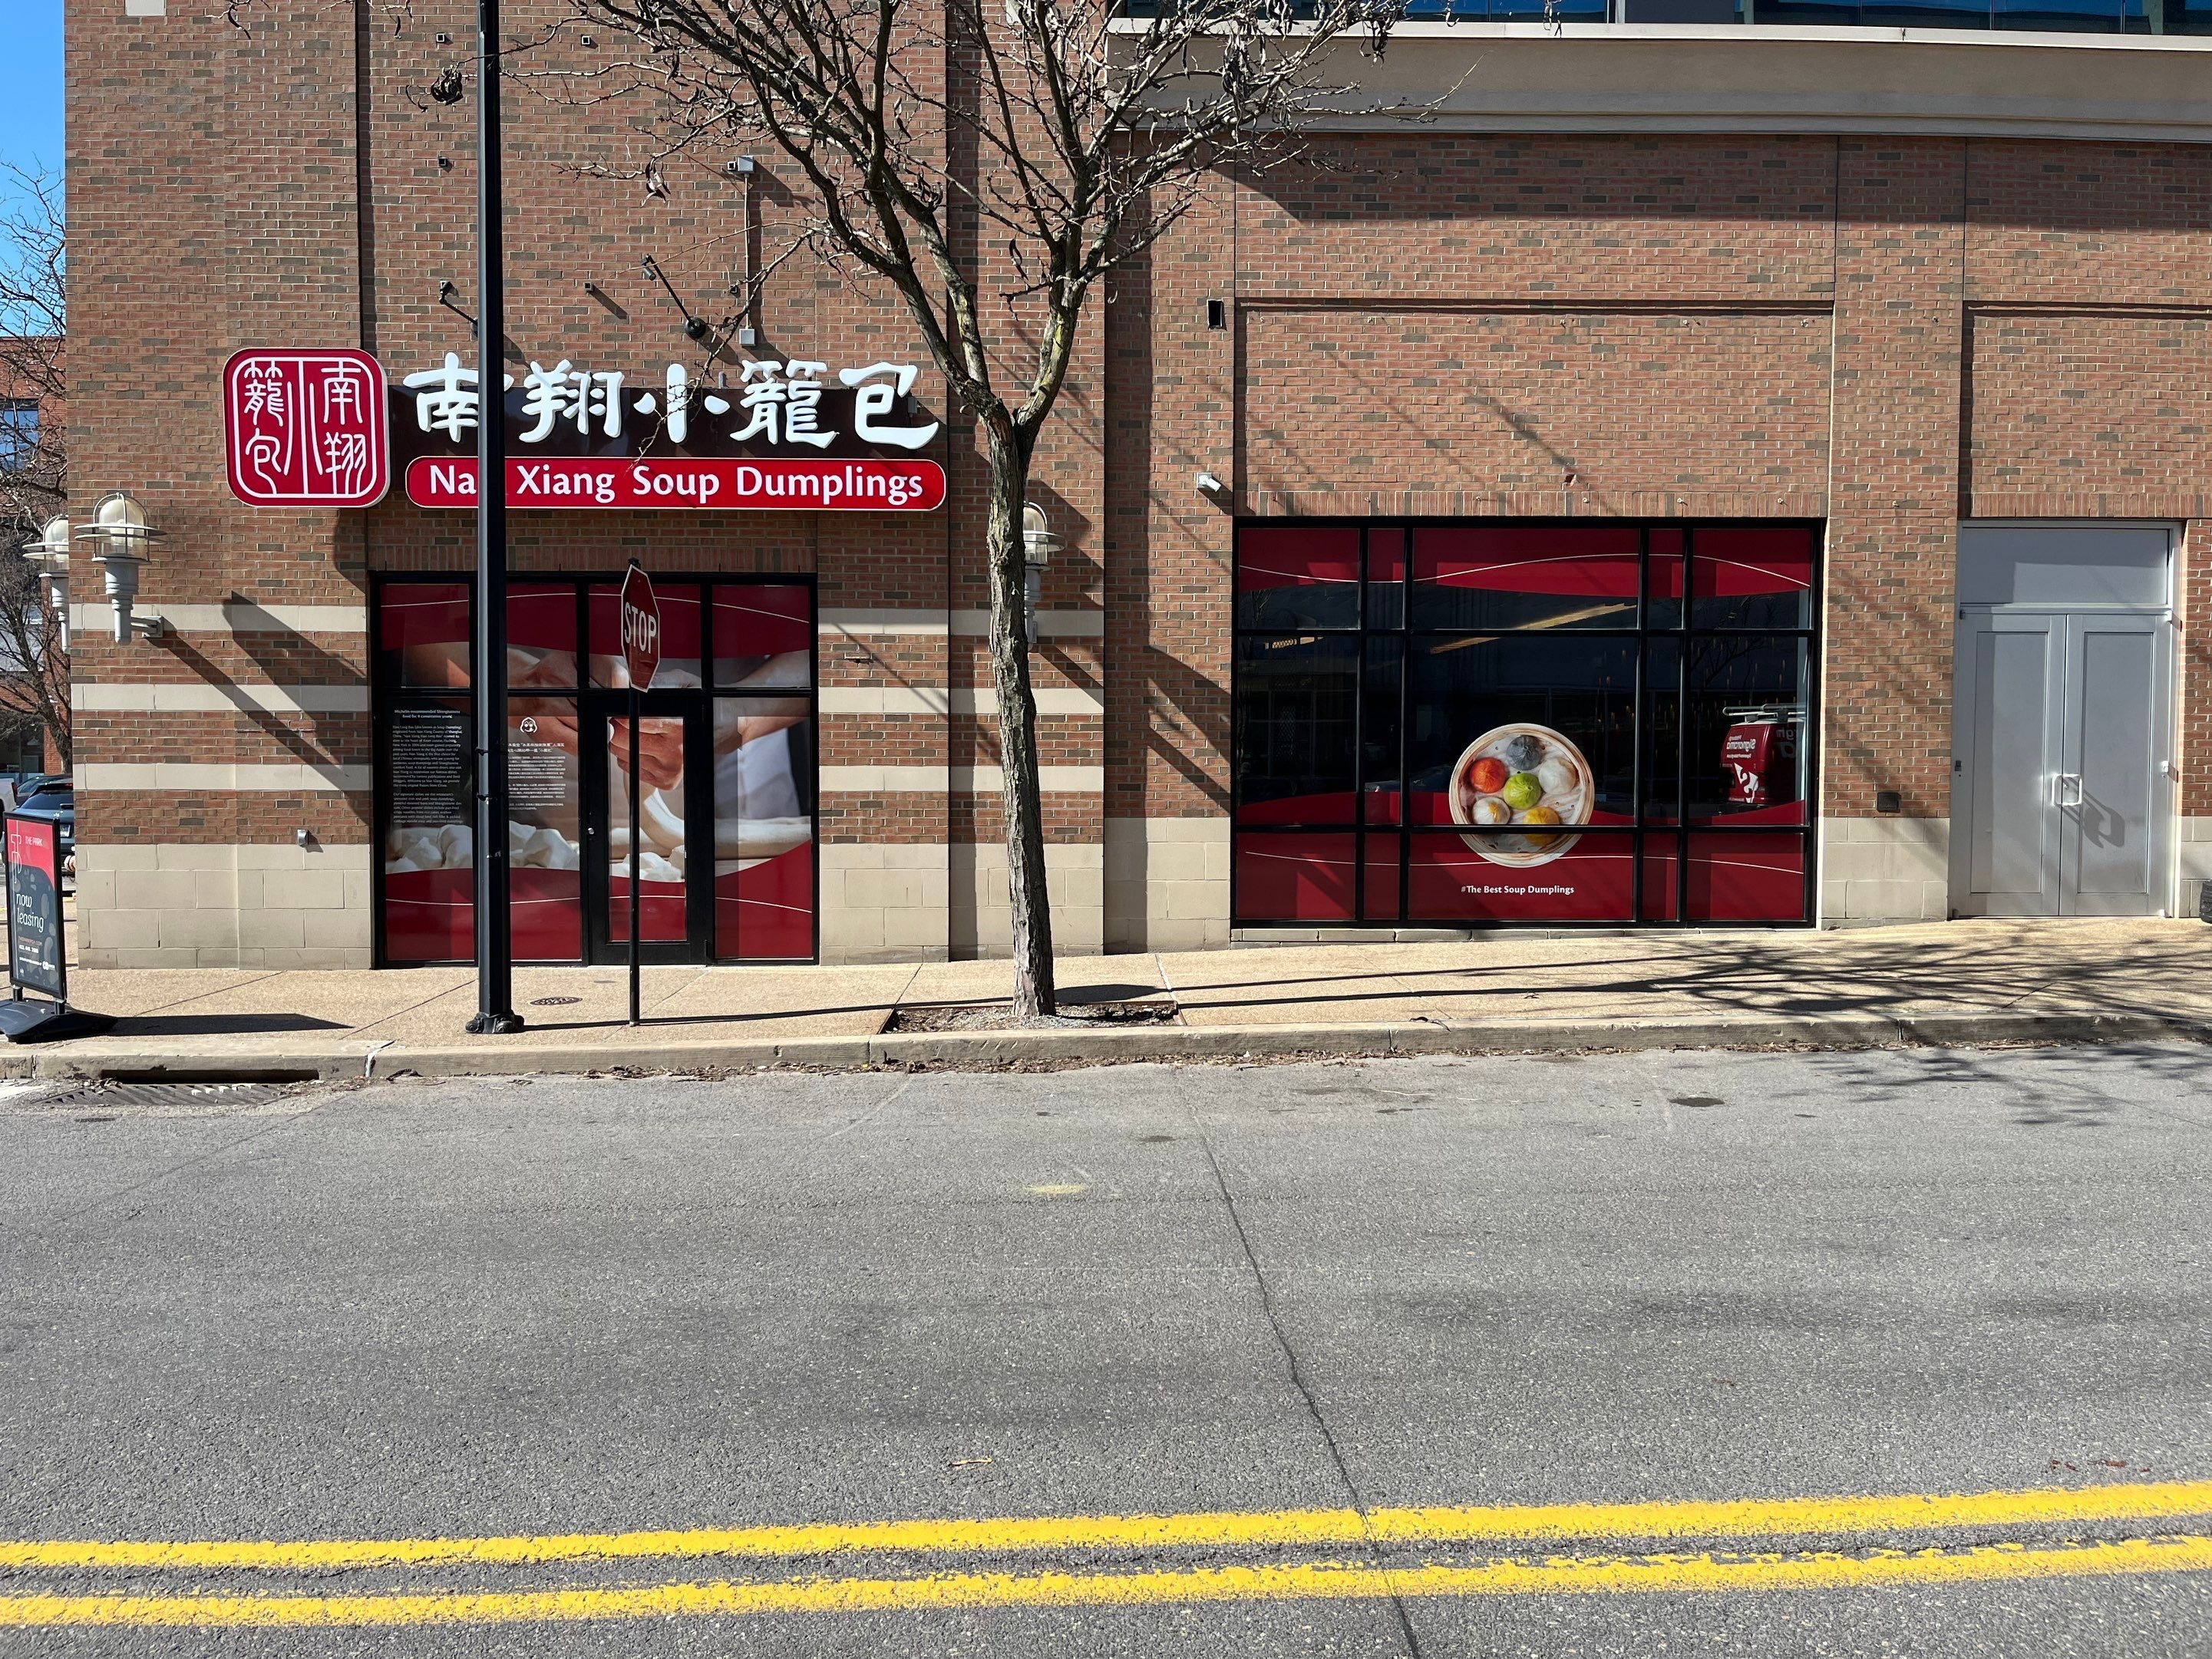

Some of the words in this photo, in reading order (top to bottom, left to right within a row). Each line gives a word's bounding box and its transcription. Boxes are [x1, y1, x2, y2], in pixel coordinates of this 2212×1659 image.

[430, 465, 476, 495] Na
[517, 464, 616, 504] Xiang
[632, 466, 720, 504] Soup
[737, 466, 923, 506] Dumplings
[624, 602, 657, 654] STOP
[16, 893, 32, 908] now
[1461, 886, 1482, 894] #The
[1484, 886, 1502, 894] Best
[1504, 886, 1526, 895] Soup
[1527, 886, 1574, 895] Dumplings
[17, 907, 45, 933] leasing
